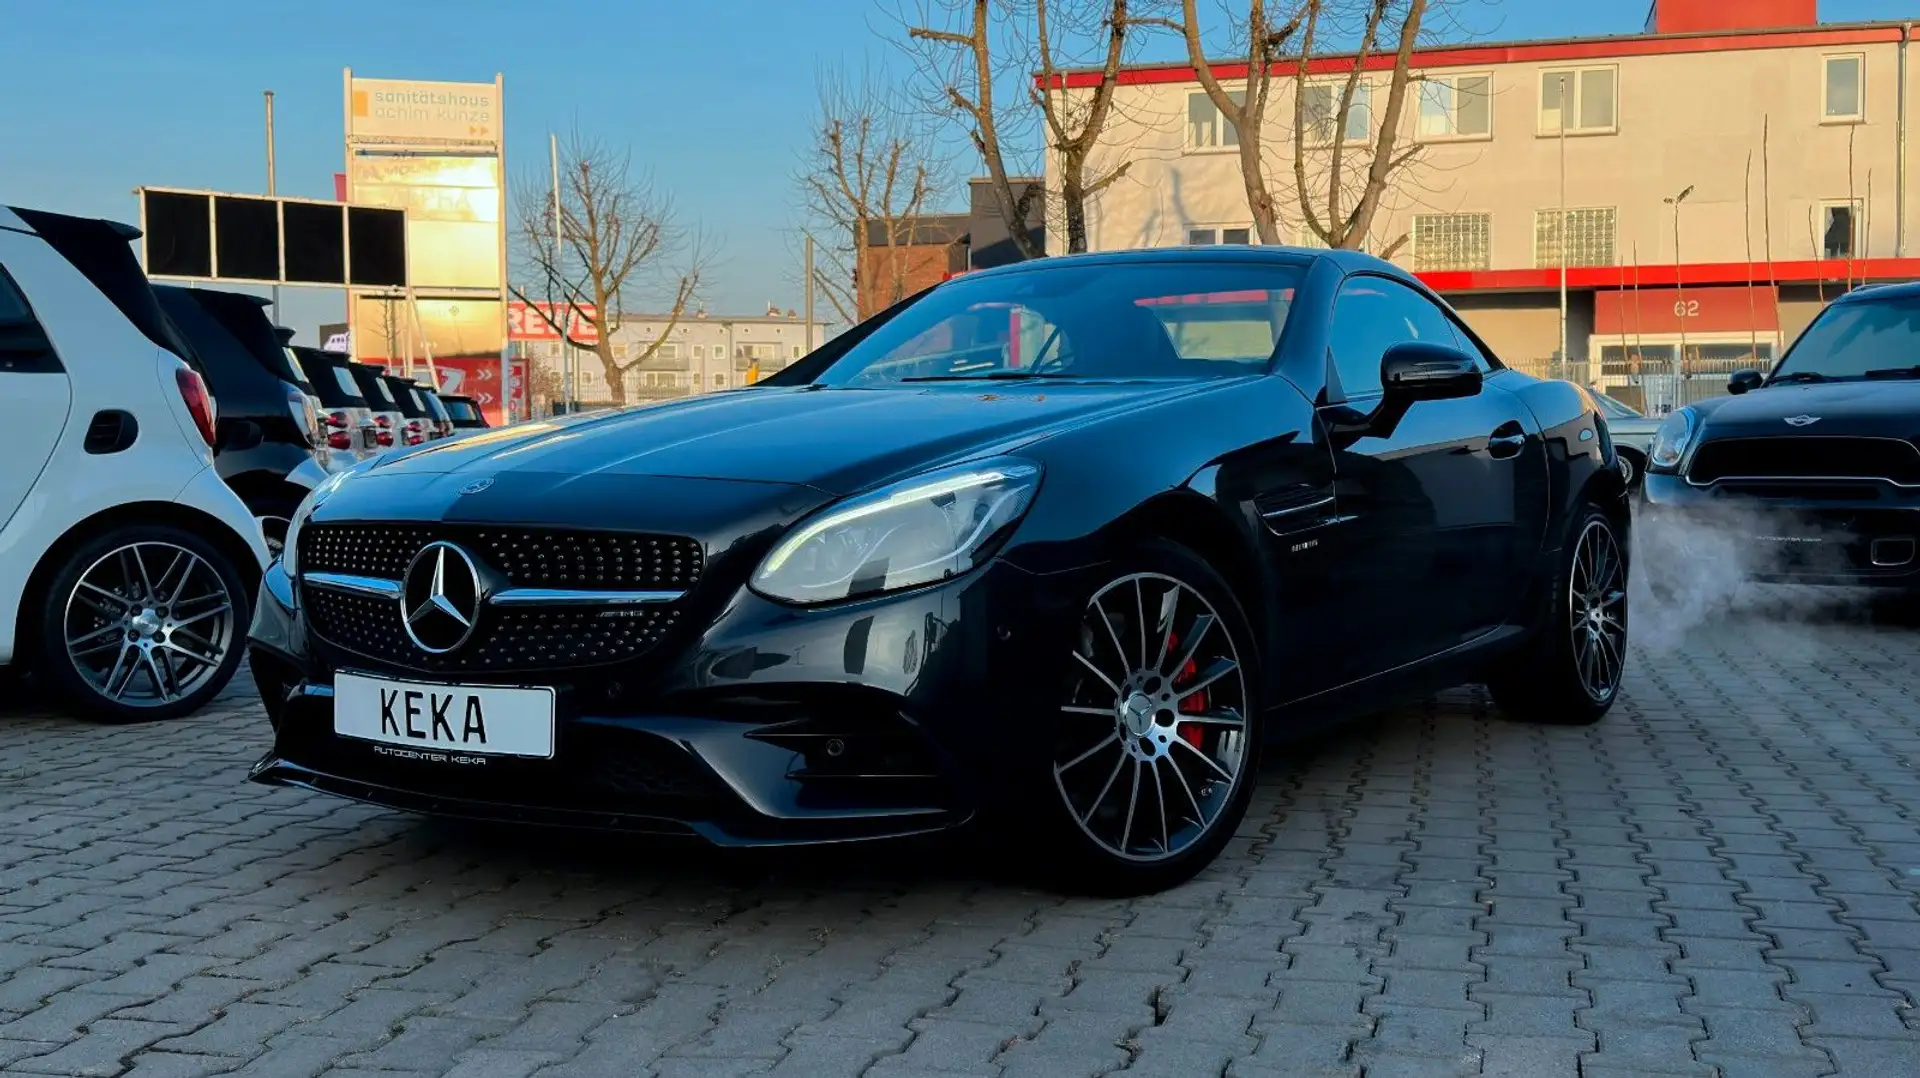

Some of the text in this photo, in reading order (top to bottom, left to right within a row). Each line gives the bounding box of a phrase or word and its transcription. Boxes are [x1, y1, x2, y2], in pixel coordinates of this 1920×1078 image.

[1674, 300, 1699, 316] 62
[380, 688, 487, 743] KEKA
[374, 746, 486, 765] AUTOCENTER KEKA
